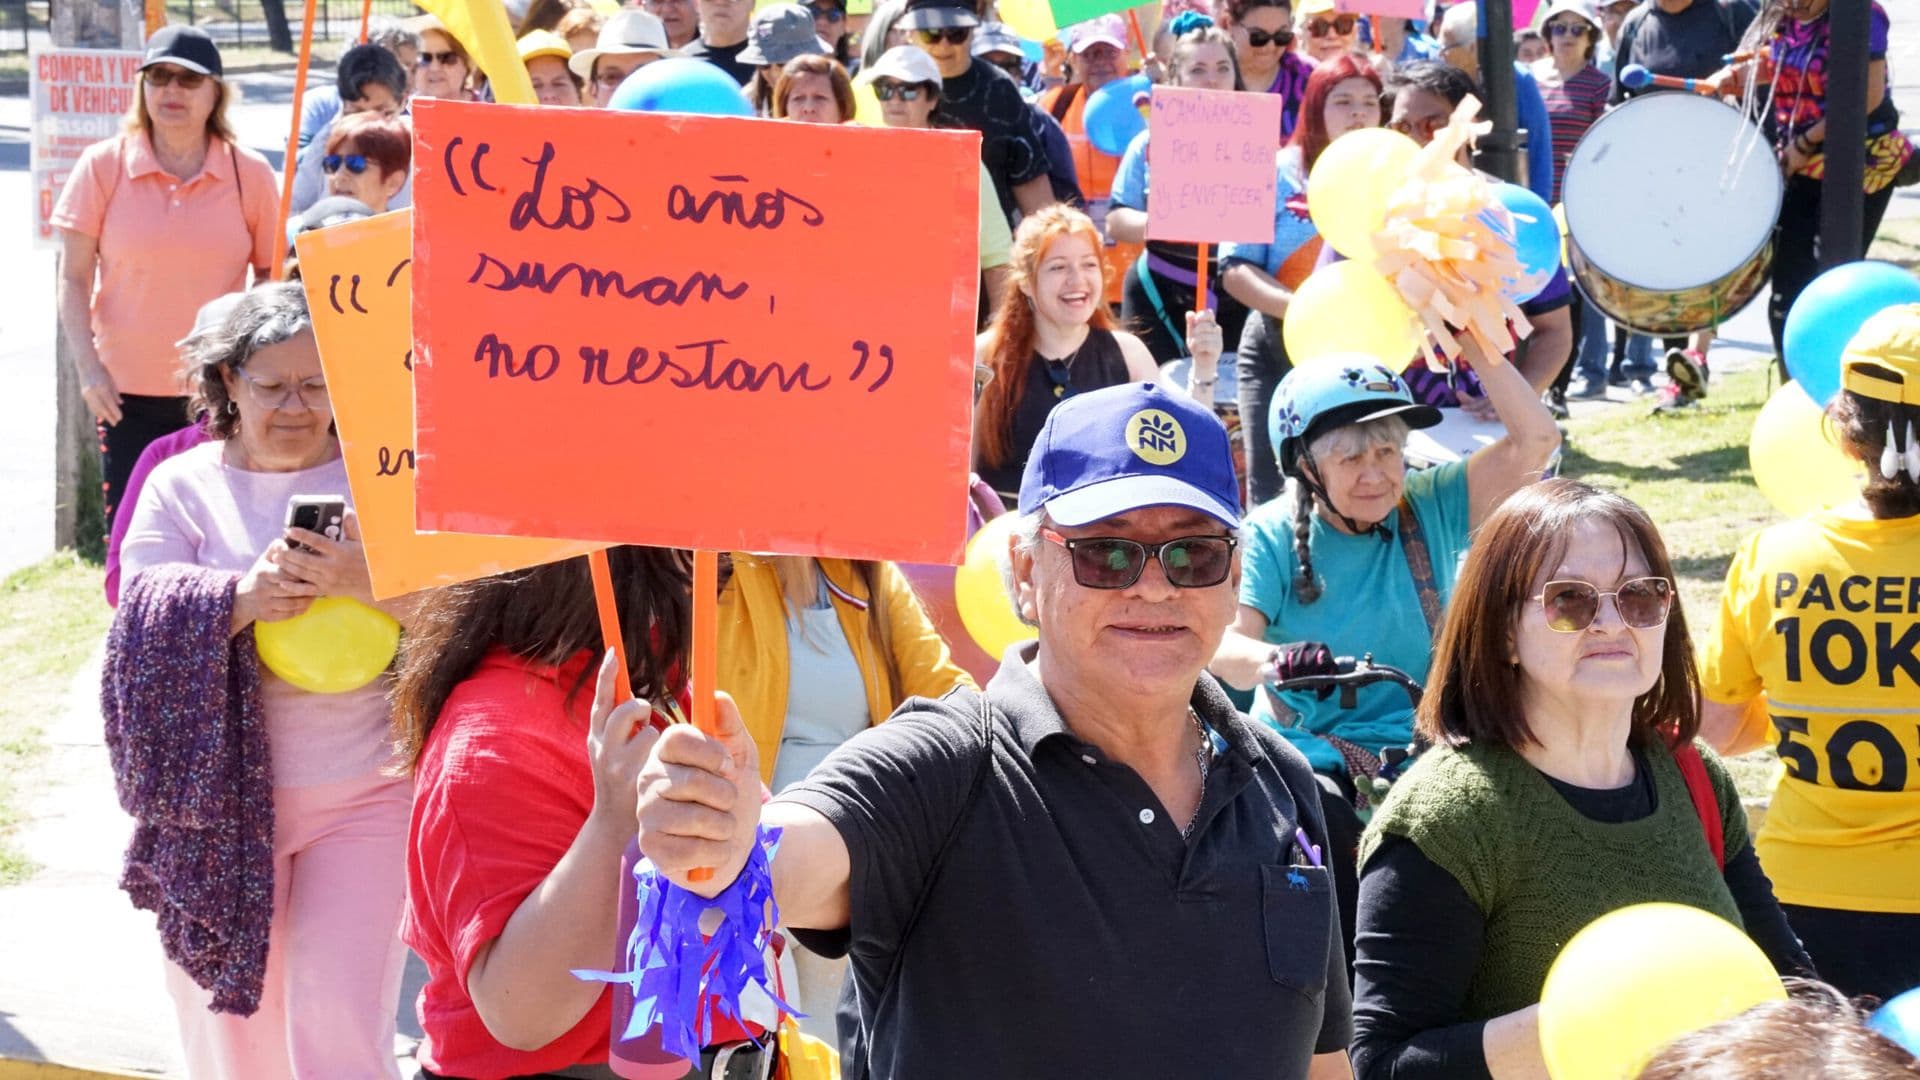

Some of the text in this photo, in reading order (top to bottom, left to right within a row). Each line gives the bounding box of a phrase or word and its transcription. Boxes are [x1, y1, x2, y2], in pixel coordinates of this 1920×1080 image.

[38, 54, 144, 84] COMPRA Y VE
[50, 86, 69, 113] DE
[1214, 140, 1232, 162] EL
[667, 174, 825, 230] años
[474, 333, 561, 381] no
